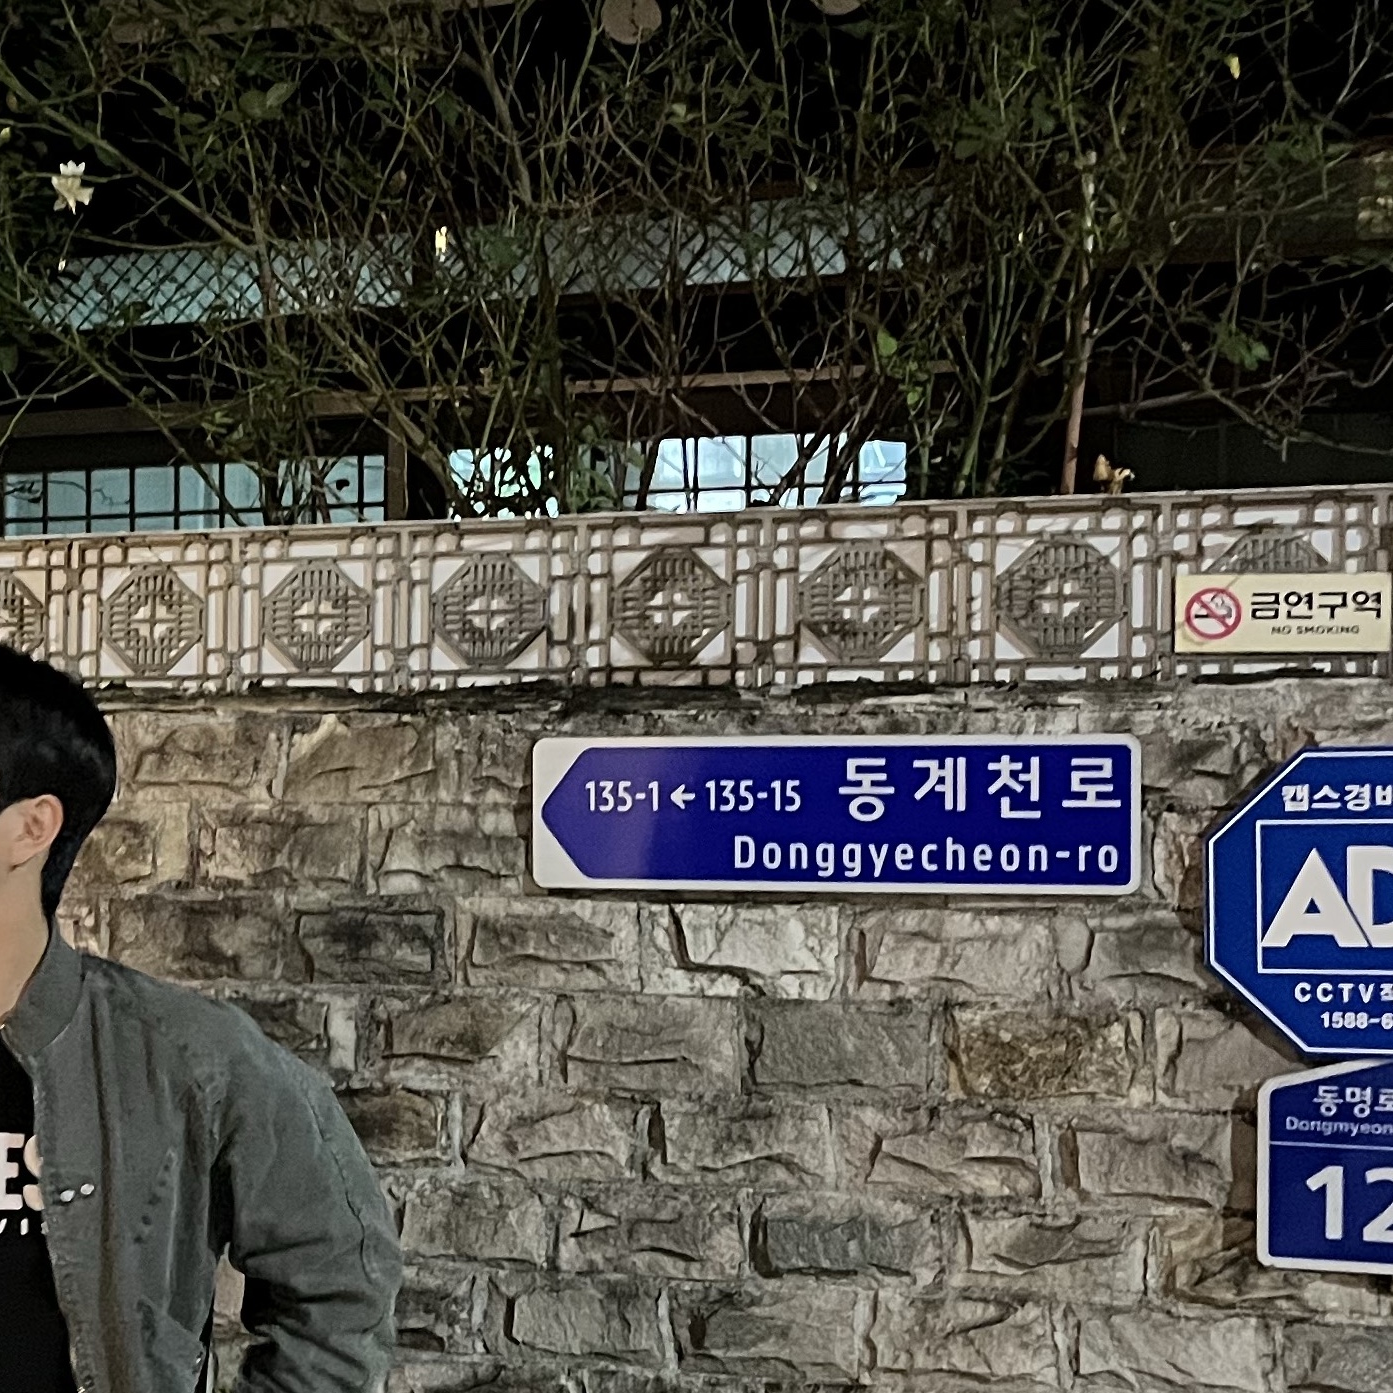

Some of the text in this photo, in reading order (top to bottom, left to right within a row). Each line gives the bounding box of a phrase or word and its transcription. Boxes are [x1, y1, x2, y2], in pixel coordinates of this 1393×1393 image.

[1251, 591, 1382, 620] 금연구역
[1271, 624, 1360, 636] NO SMOKING
[584, 755, 1122, 822] 135-1 135-15 동계천로
[734, 835, 1120, 878] Donggyecheon-ro
